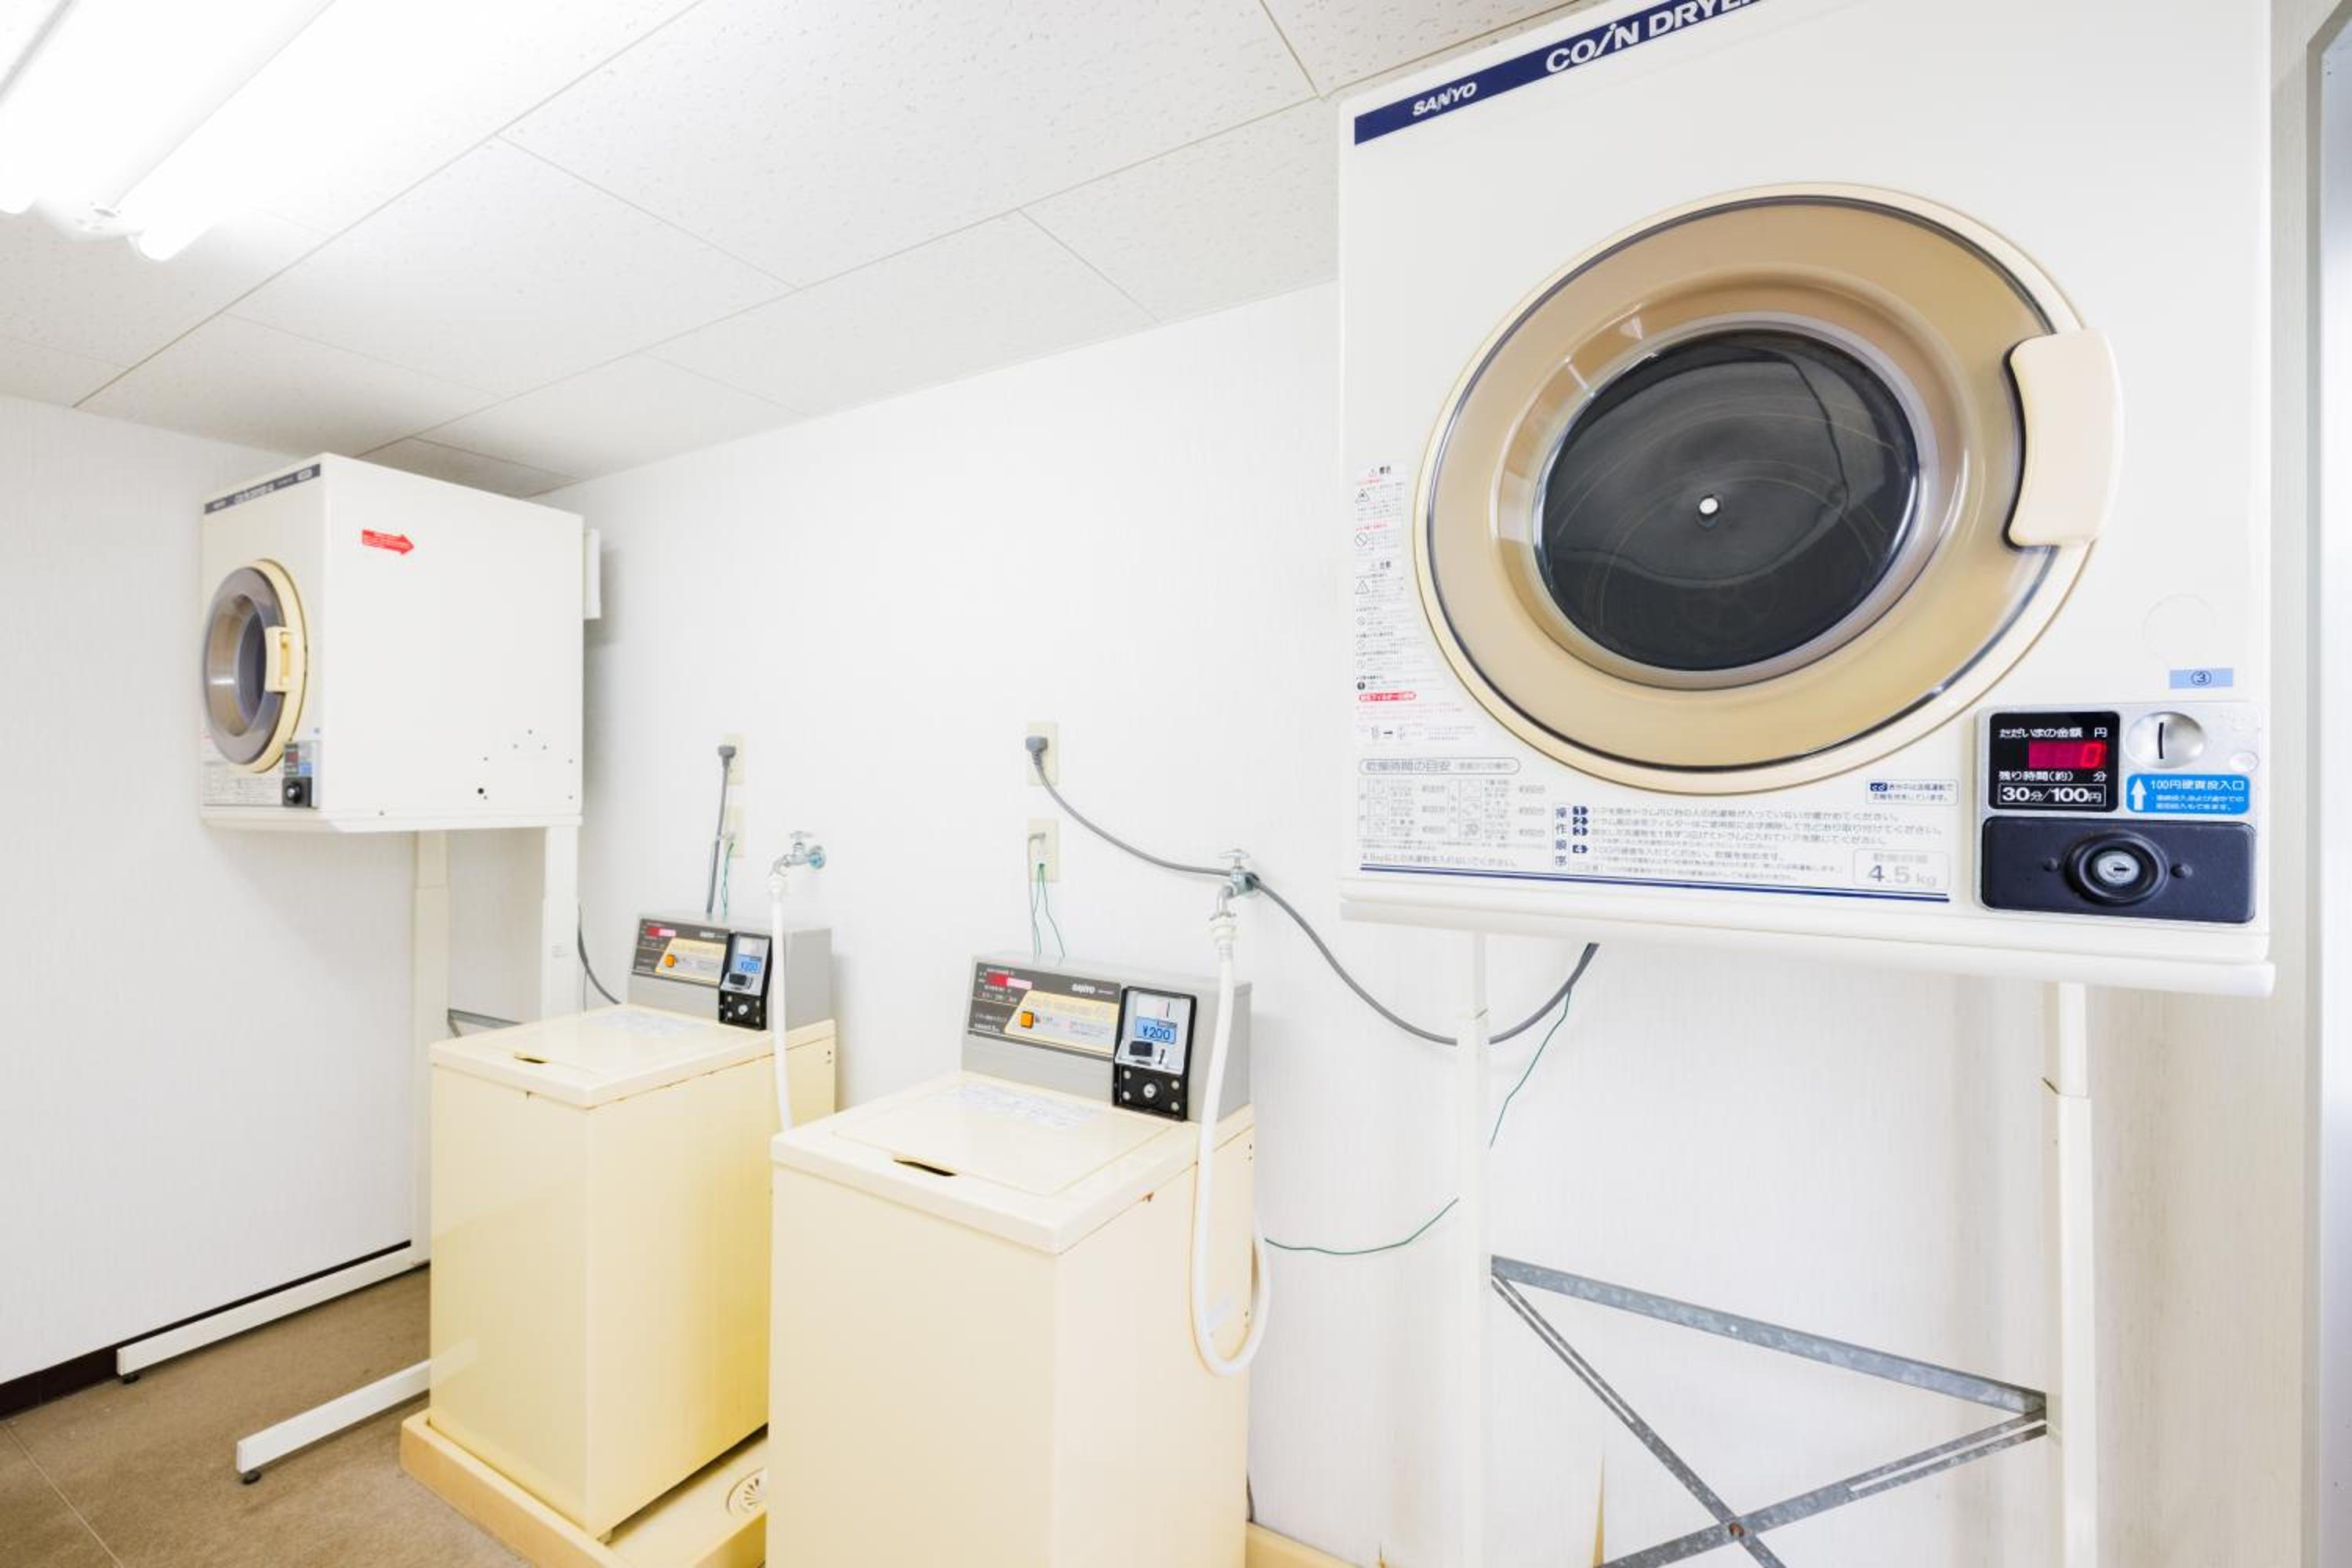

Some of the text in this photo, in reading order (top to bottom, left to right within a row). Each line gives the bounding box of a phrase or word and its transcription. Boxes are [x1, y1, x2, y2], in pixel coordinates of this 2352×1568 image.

[1412, 82, 1477, 117] SANYO
[1649, 0, 1751, 38] DRY
[1999, 728, 2107, 738] ただいまの金額 円
[2082, 742, 2103, 768] 0
[2093, 771, 2107, 781] 分
[1142, 1024, 1171, 1040] ¥200
